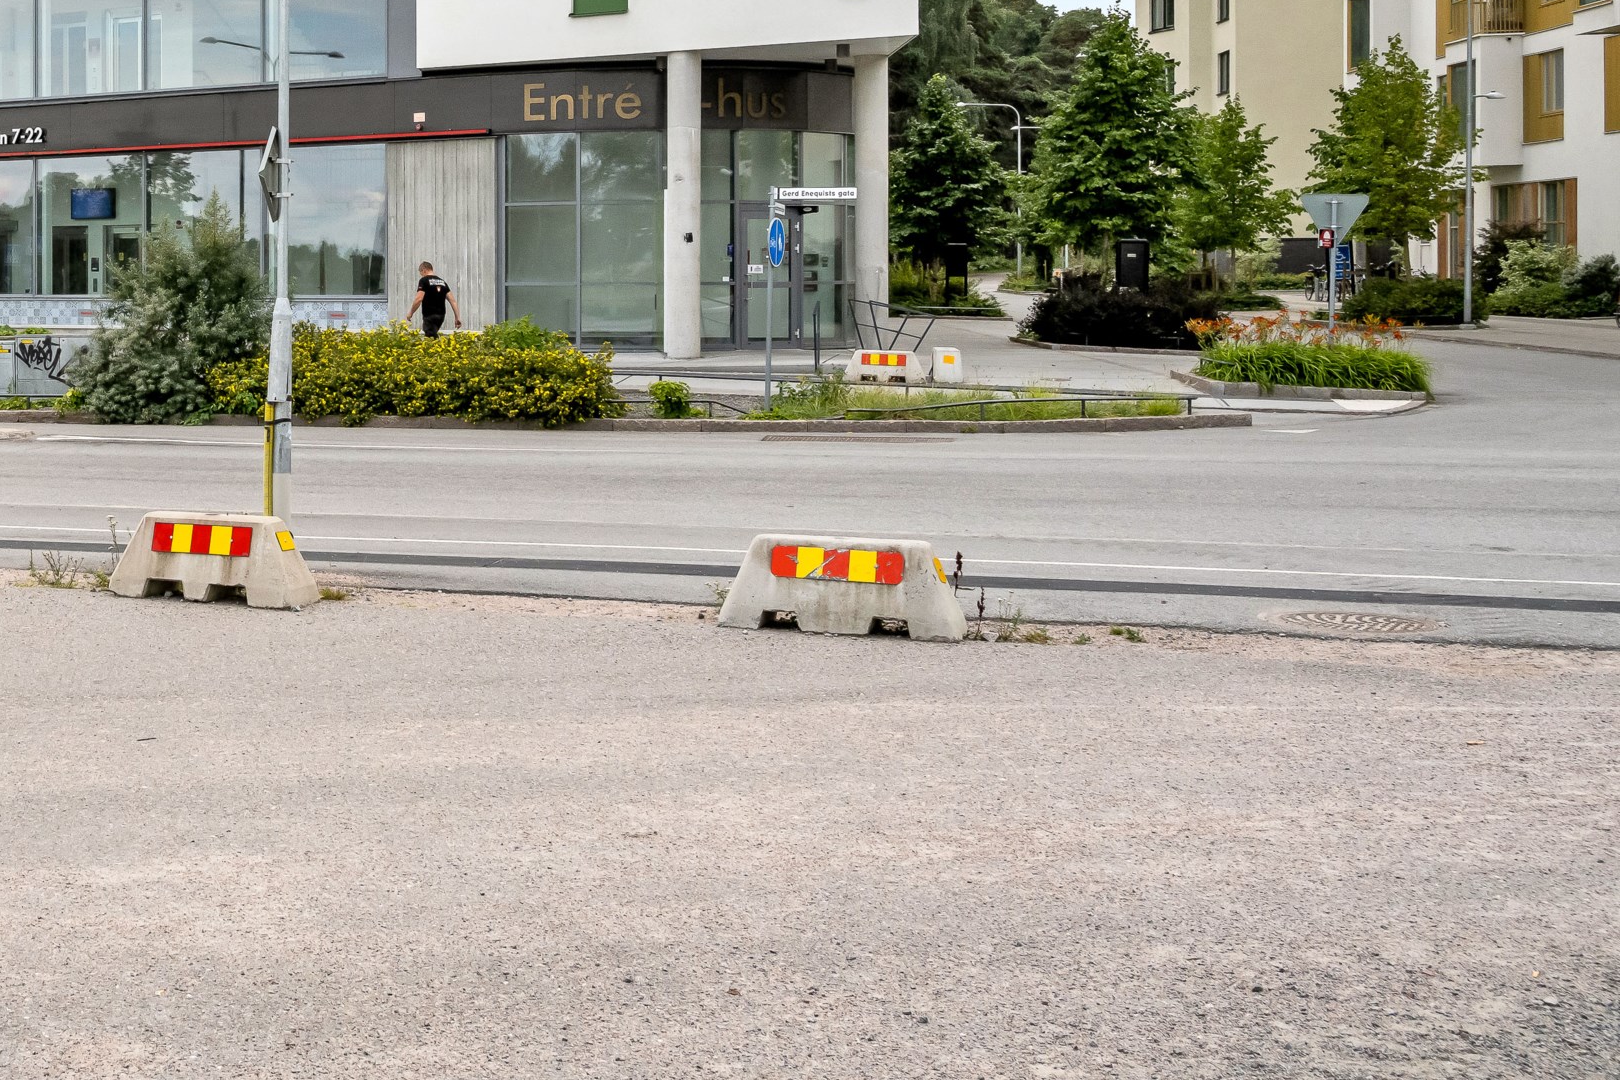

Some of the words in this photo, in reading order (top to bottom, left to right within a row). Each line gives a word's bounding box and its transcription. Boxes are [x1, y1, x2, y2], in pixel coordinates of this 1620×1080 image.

[523, 80, 642, 121] Entré
[701, 77, 787, 119] -hus
[11, 126, 43, 145] 7-22
[801, 190, 836, 198] Enequists
[838, 190, 855, 198] gata
